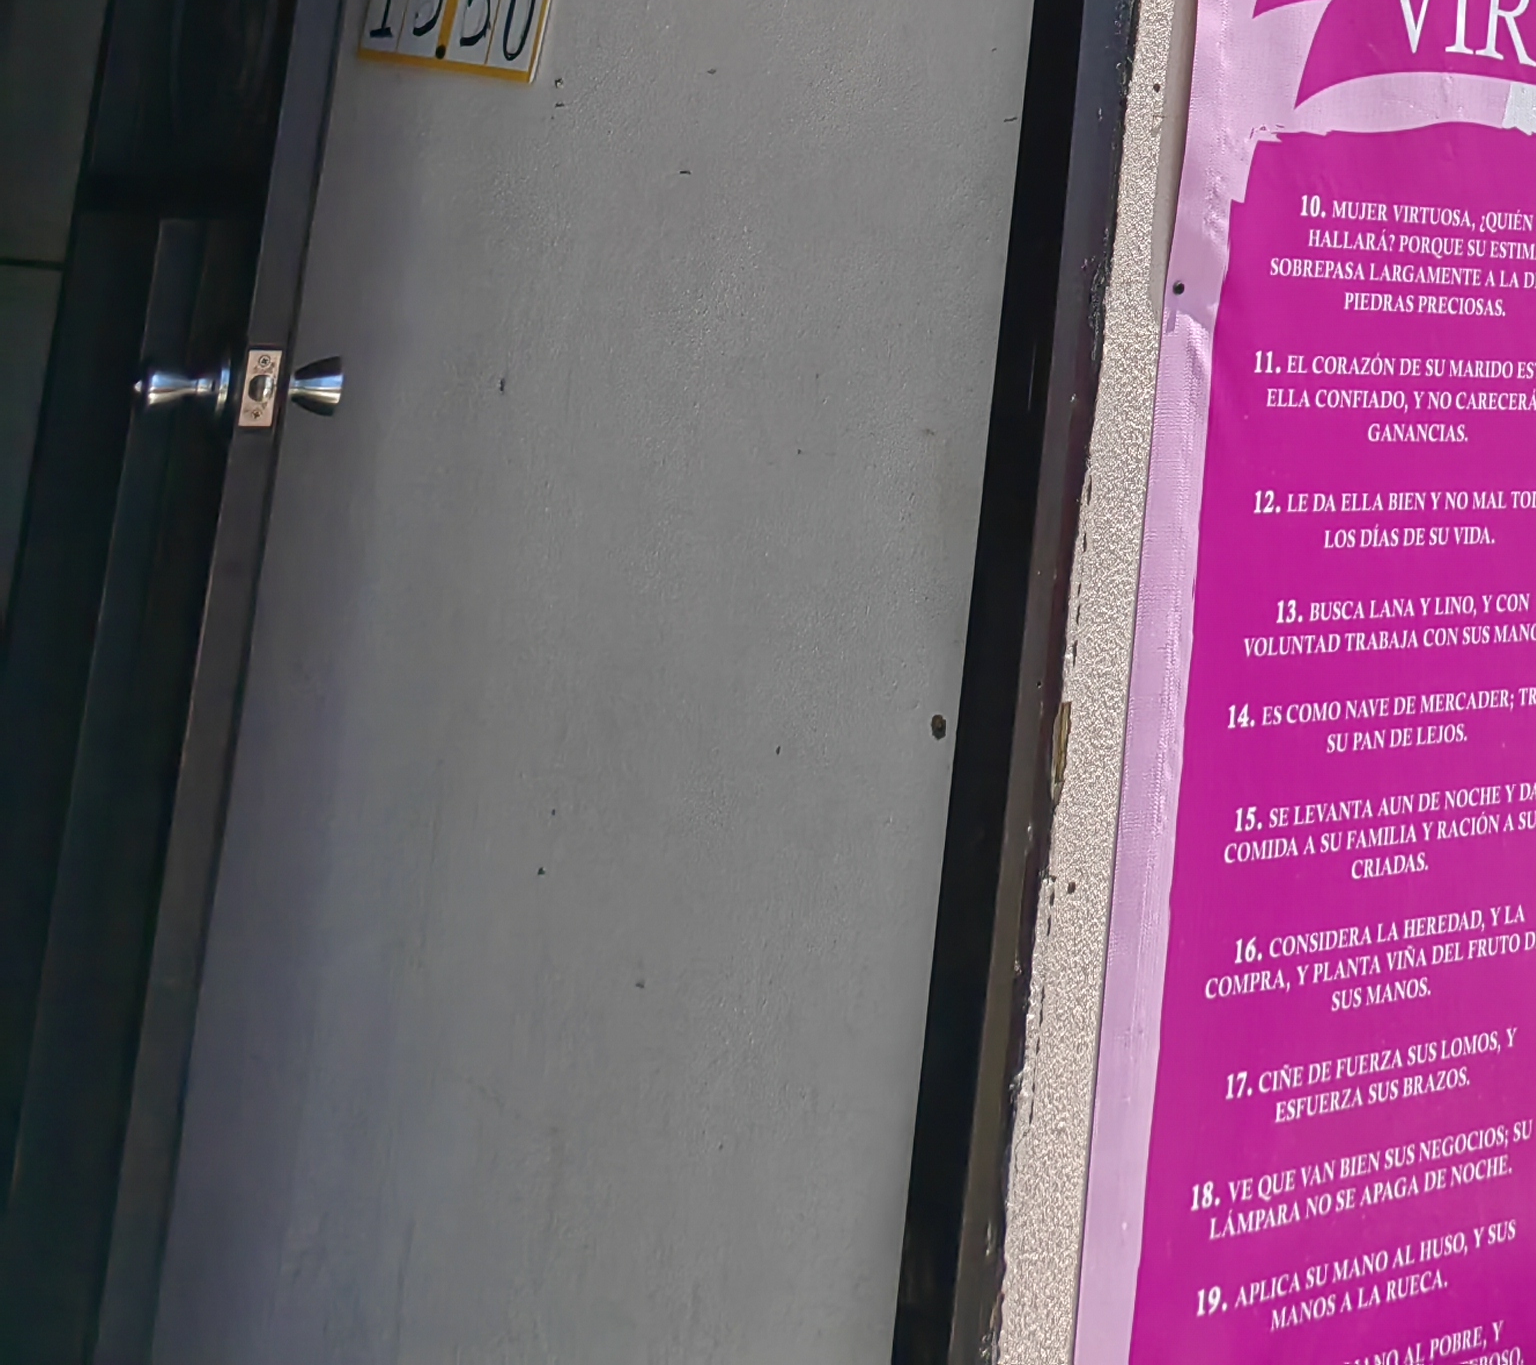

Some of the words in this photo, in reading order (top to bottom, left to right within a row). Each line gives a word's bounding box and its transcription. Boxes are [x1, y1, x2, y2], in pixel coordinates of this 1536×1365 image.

[1301, 195, 1326, 218] 10.
[1333, 201, 1387, 221] MUJER
[1393, 205, 1475, 231] VIRTUOSA,
[1480, 210, 1533, 233] ¿QUIÉN
[1309, 229, 1395, 251] HALLARÁ?
[1399, 235, 1463, 259] PORQUE
[1467, 240, 1486, 257] SU
[1270, 258, 1365, 280] SOBREPASA
[1370, 263, 1481, 286] LARGAMENTE
[1485, 271, 1495, 287] A
[1500, 270, 1519, 288] LA
[1344, 292, 1414, 312] PIEDRAS
[1418, 296, 1505, 316] PRECIOSAS.
[1197, 1286, 1227, 1316] 19.
[1235, 1273, 1300, 1307] APLICA
[1306, 1264, 1328, 1289] SU
[1333, 1251, 1388, 1282] MANO
[1393, 1245, 1414, 1268] AL
[1420, 1232, 1468, 1261] HUSO,
[1474, 1227, 1484, 1248] Y
[1488, 1220, 1515, 1244] SUS
[1272, 1294, 1335, 1330] MANOS
[1341, 1292, 1352, 1312] A
[1358, 1285, 1380, 1308] LA
[1387, 1270, 1447, 1302] RUECA.
